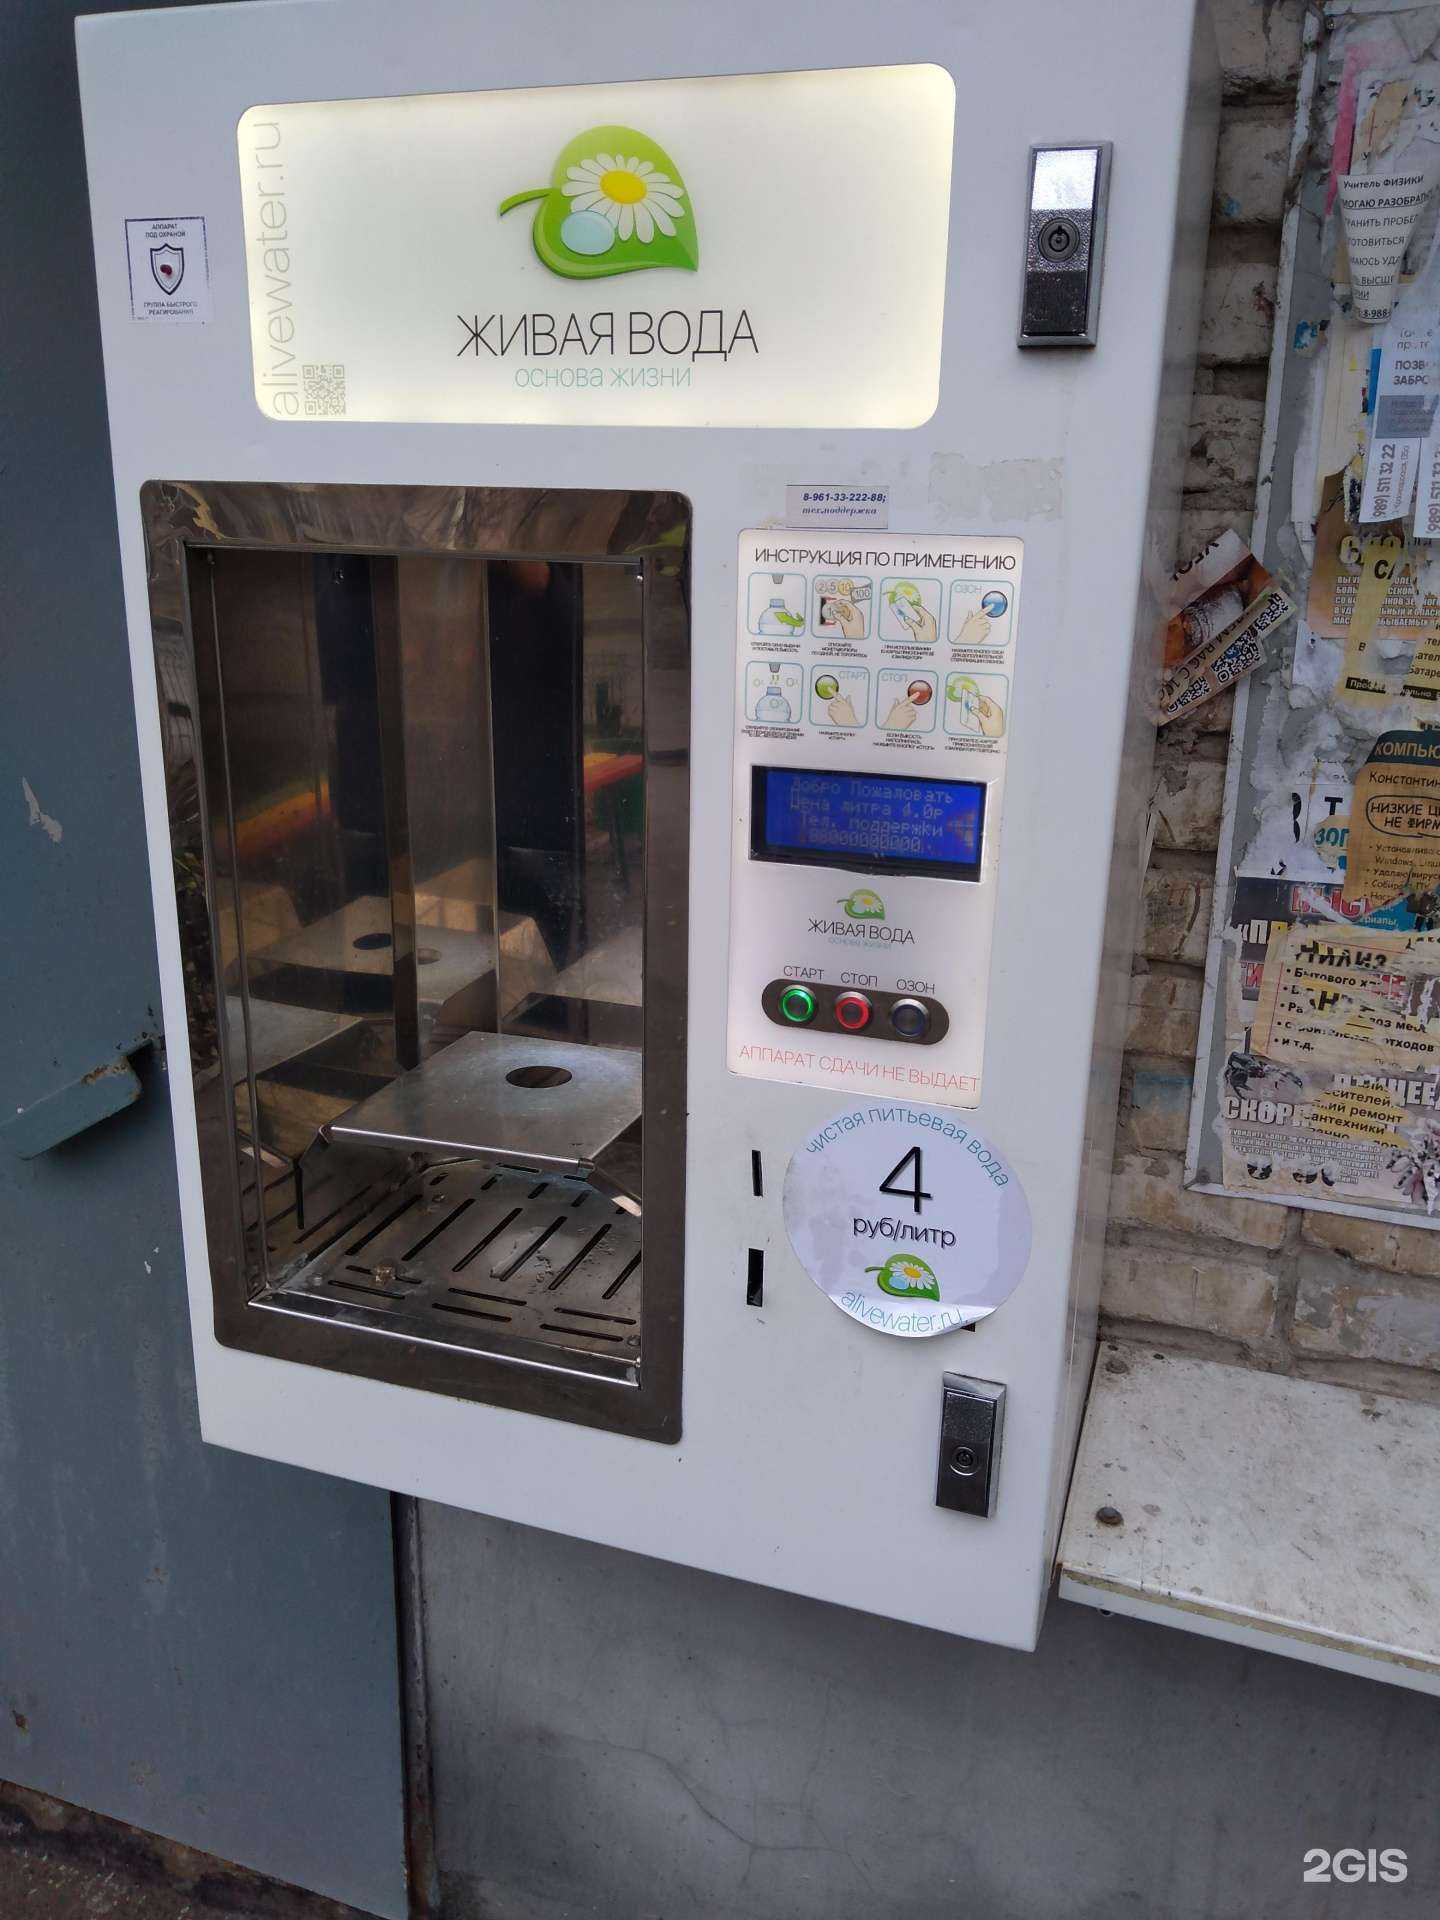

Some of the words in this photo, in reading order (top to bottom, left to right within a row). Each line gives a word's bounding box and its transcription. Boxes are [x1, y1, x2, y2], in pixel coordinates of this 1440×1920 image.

[1344, 179, 1381, 190] Учитель
[1383, 175, 1424, 186] ФИЗИКИ
[253, 120, 300, 416] alivewater.ru
[457, 312, 615, 357] ЖИВАЯ
[629, 309, 759, 362] ВОДА
[515, 365, 605, 388] основа
[609, 363, 692, 389] жизни
[755, 547, 862, 568] ИНСТРУКЦИЯ
[865, 552, 890, 567] ПО
[893, 552, 1016, 571] ПРИМЕНЕНИЮ
[850, 780, 954, 803] Пожаловать
[1370, 802, 1424, 816] НИЗКИЕ
[1384, 816, 1403, 828] НЕ
[850, 817, 944, 838] поддержки
[808, 917, 866, 938] ЖИВАЯ
[869, 925, 915, 945] ВОДА
[783, 965, 824, 980] СТАРТ
[840, 972, 878, 987] СТОП
[896, 978, 935, 994] ОЗОН
[739, 1046, 815, 1068] АППАРАТ
[818, 1055, 880, 1077] СДАЧИ
[883, 1062, 905, 1081] НЕ
[908, 1067, 981, 1093] ВЫДАЕТ
[1349, 1106, 1404, 1124] ремонт
[806, 1112, 865, 1153] чистая
[868, 1108, 968, 1145] питьевая
[966, 1139, 1009, 1187] вода
[879, 1146, 933, 1213] 4
[853, 1217, 957, 1248] руб/литр
[840, 1291, 964, 1332] alivewater.ru
